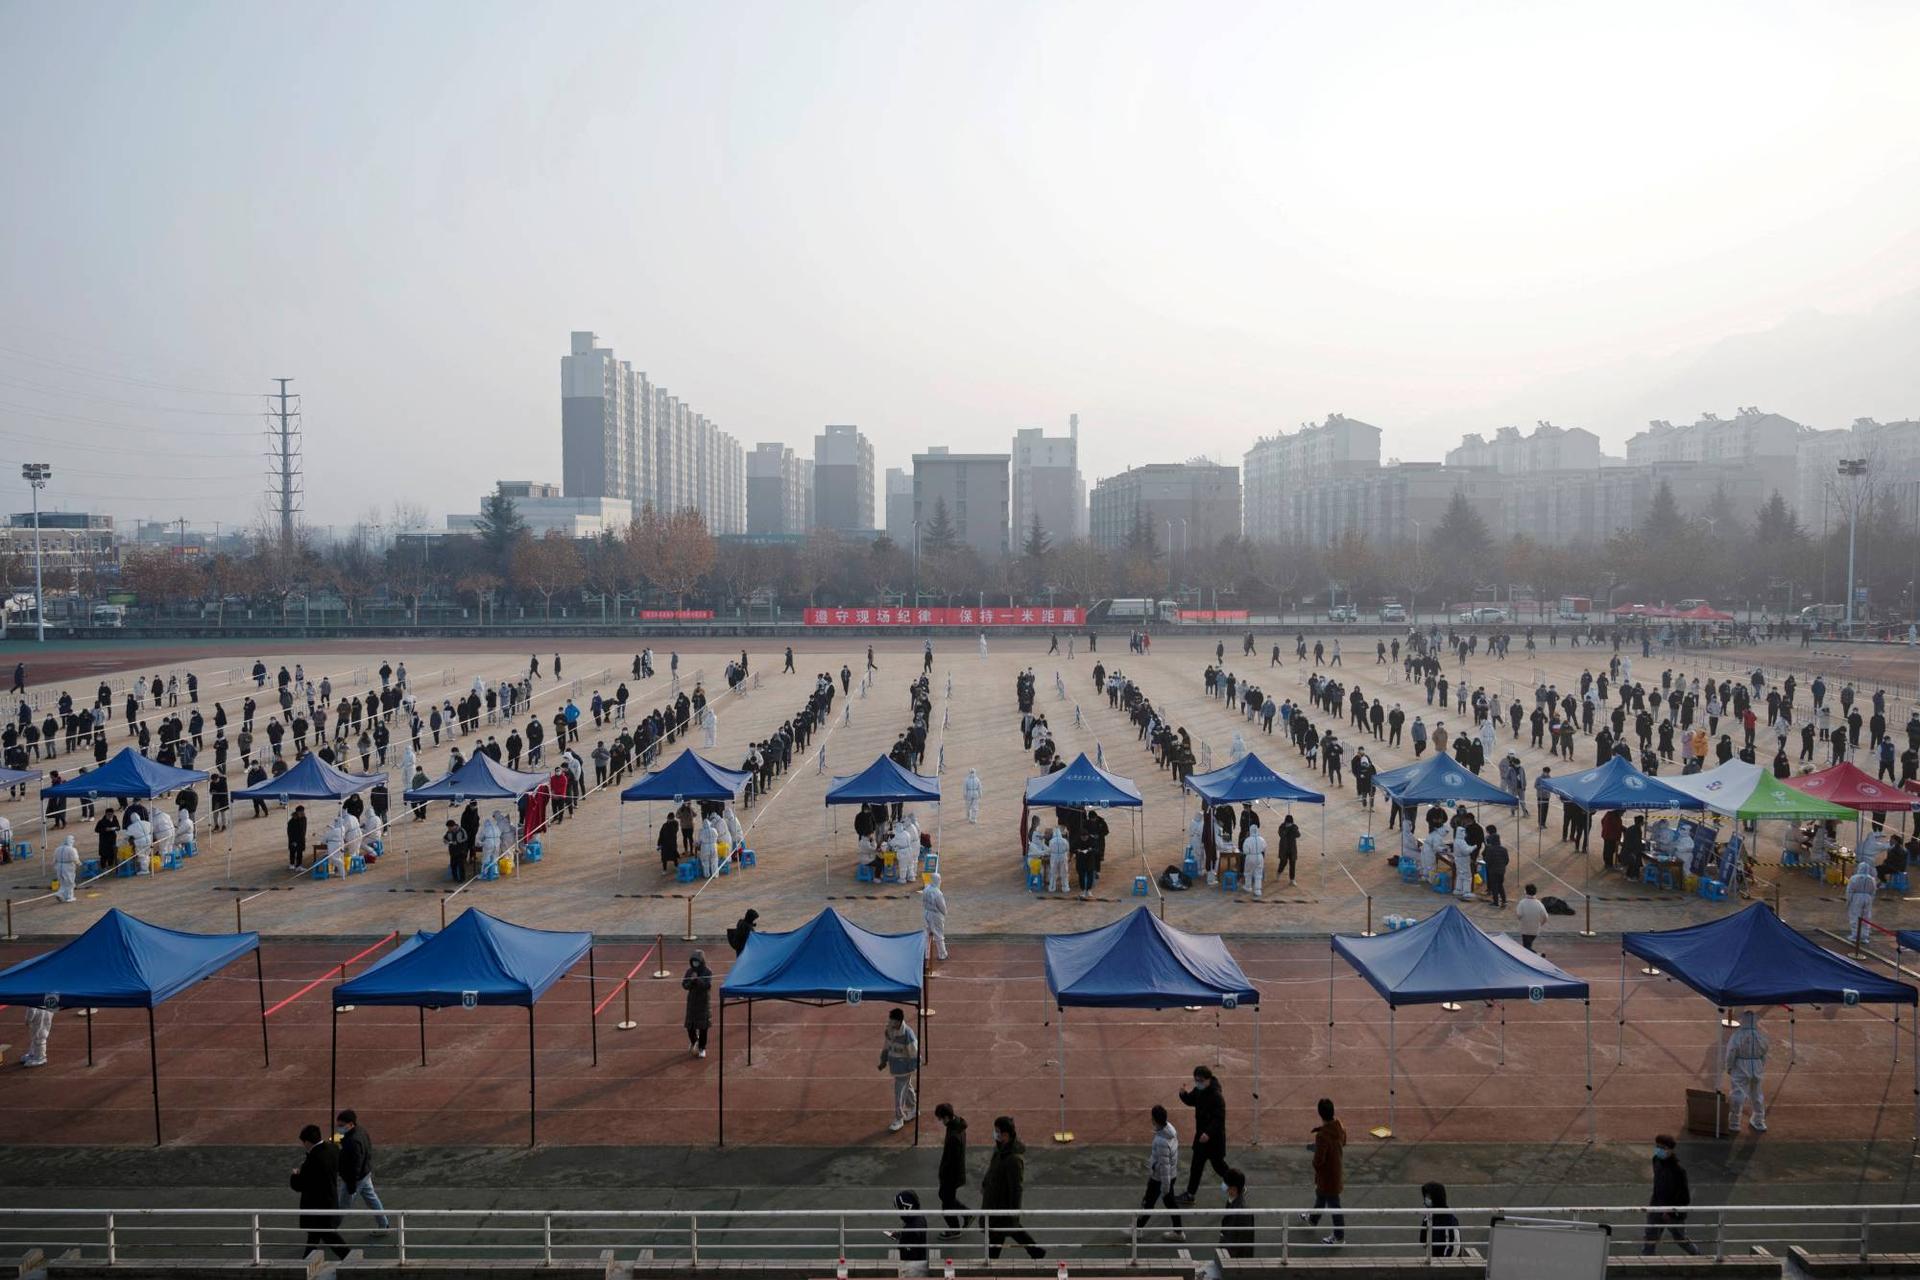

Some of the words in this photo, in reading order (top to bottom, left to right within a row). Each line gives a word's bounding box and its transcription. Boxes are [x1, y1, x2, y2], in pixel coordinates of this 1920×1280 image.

[850, 991, 860, 1002] 10
[1532, 987, 1541, 1000] 8
[465, 995, 475, 1005] 11
